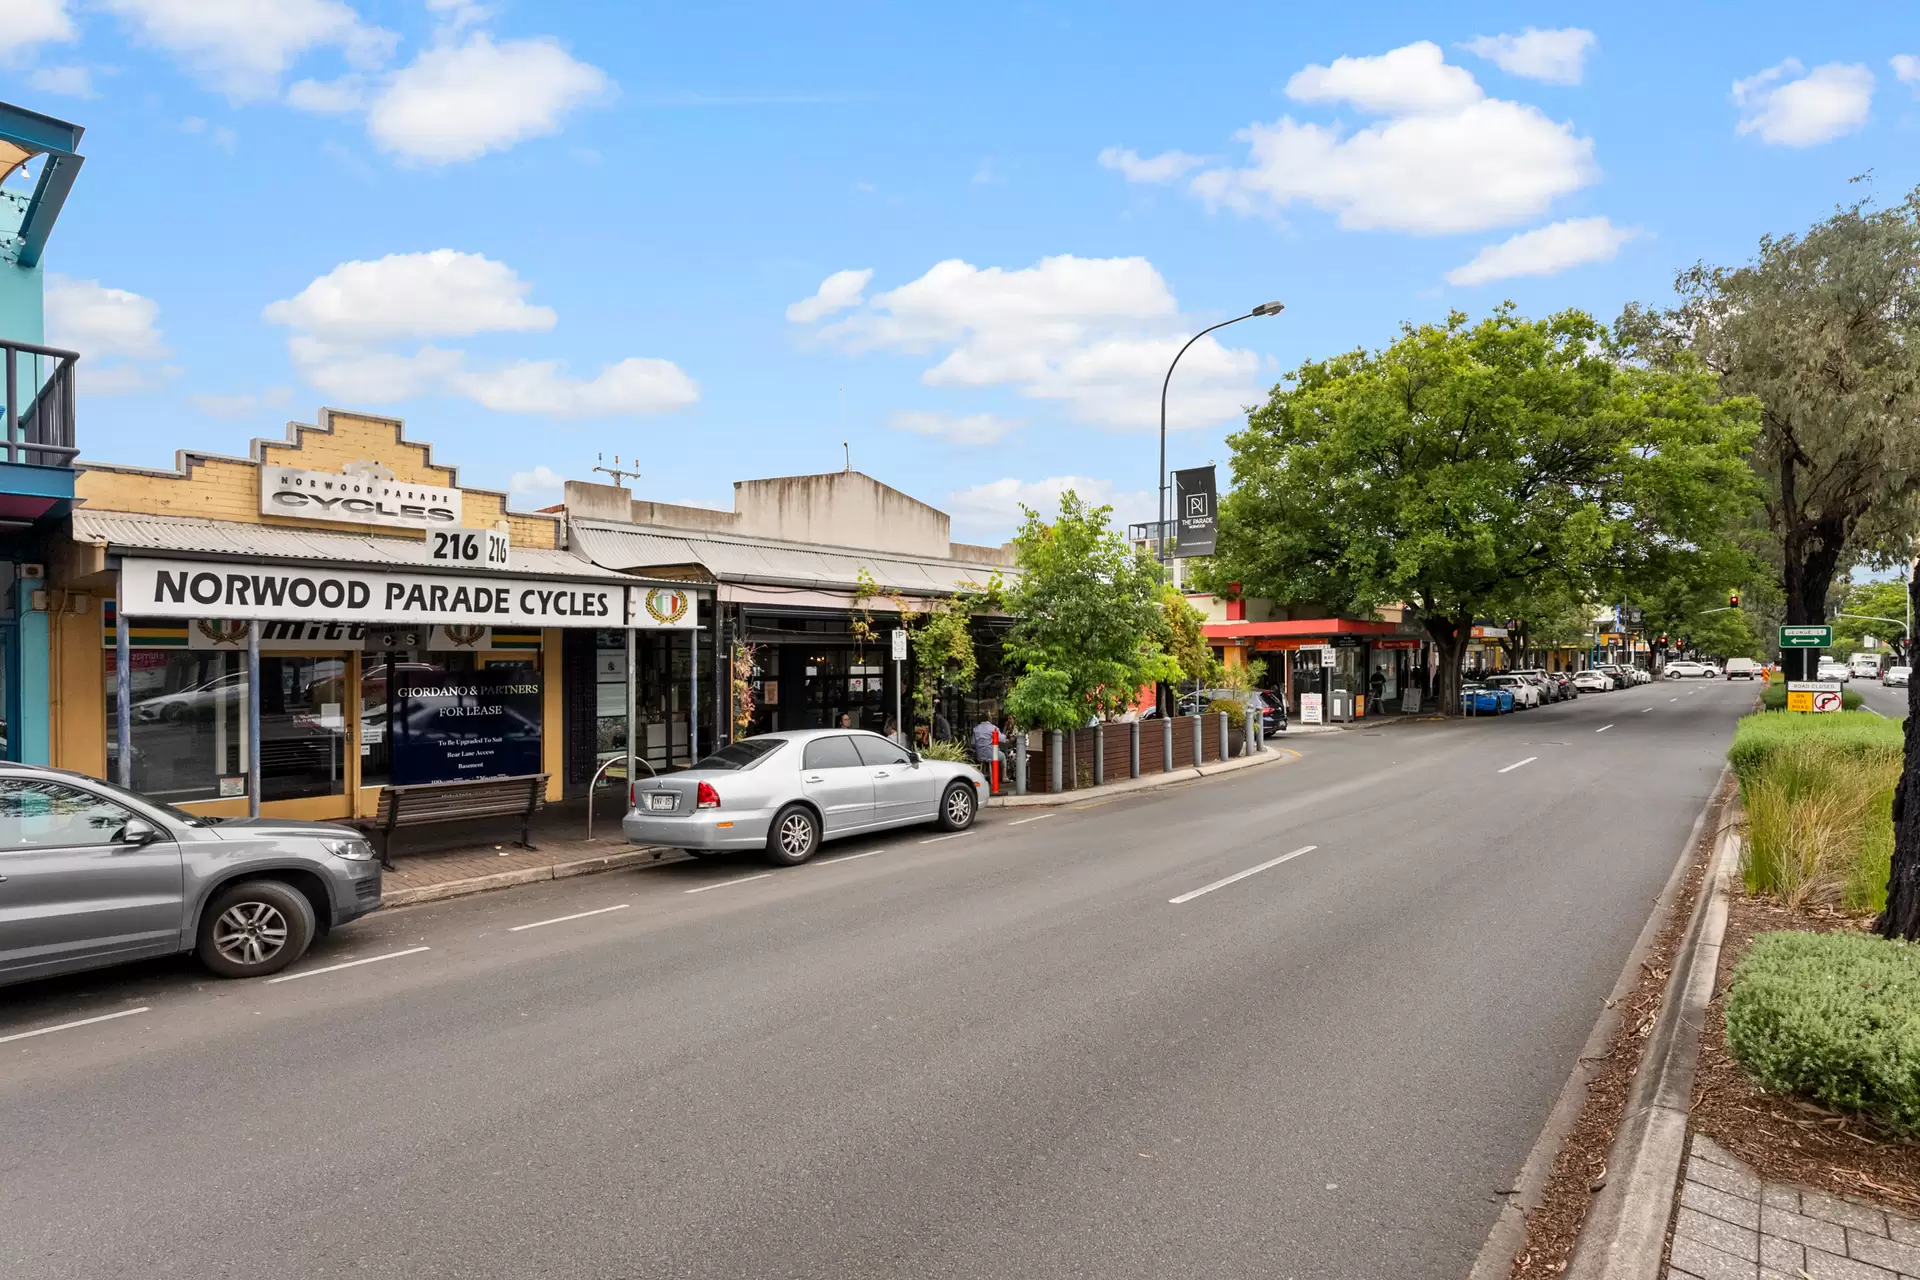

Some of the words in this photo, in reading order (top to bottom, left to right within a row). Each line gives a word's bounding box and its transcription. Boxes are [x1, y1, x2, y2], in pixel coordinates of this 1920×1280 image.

[281, 476, 373, 494] NORWOOD
[384, 488, 448, 503] PARADE
[272, 490, 455, 522] CYCLES
[1192, 517, 1213, 525] PARADE
[433, 532, 479, 561] 216
[488, 535, 507, 564] 216
[154, 570, 371, 609] NORWOOD
[385, 582, 510, 614] PARADE
[519, 589, 609, 617] CYCLES
[397, 685, 468, 698] GIORDANO
[469, 685, 478, 696] &
[480, 684, 539, 695] PARTNERS
[439, 706, 464, 717] FOR
[466, 705, 503, 716] LEASE
[456, 737, 483, 746] Upgraded
